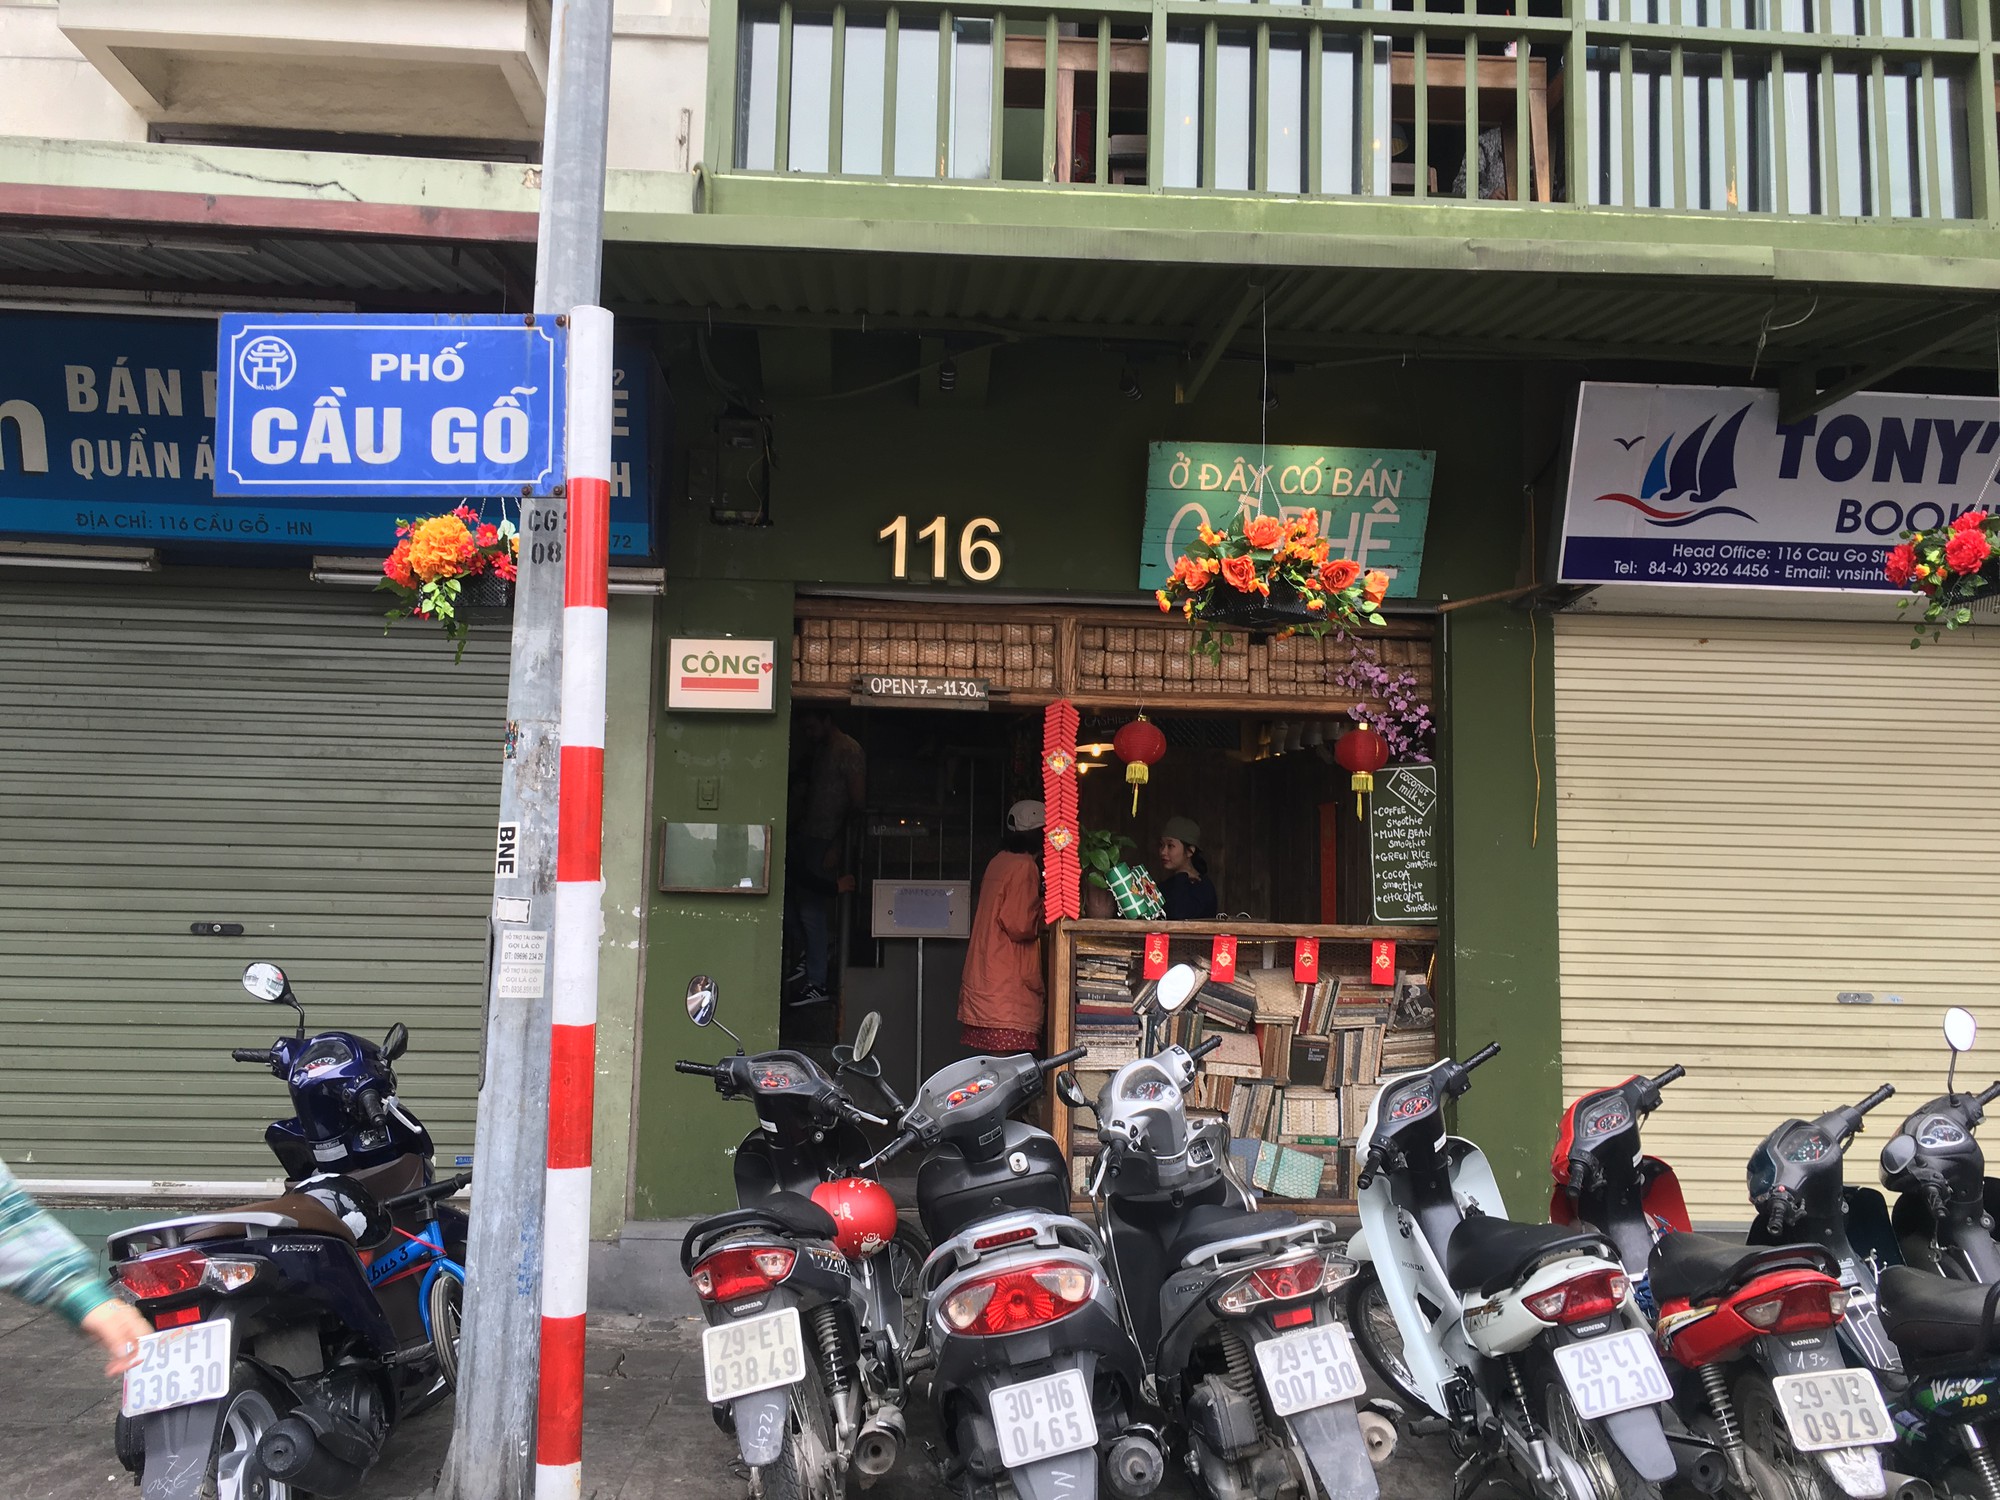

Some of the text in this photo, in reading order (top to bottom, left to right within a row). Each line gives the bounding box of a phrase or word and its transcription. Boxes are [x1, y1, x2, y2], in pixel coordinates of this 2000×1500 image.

[371, 341, 468, 382] PHỐ
[64, 356, 183, 417] BÁN
[251, 386, 402, 464] CẦU
[431, 386, 538, 464] GỖ
[71, 428, 181, 480] QUẦN
[1168, 452, 1402, 498] Ở ĐÂY CÓ BÁN
[76, 510, 109, 530] ĐỊA
[114, 510, 152, 529] CHỈ:
[159, 516, 189, 531] 116
[193, 512, 234, 532] CẦU
[238, 513, 269, 533] GỖ
[287, 521, 312, 535] HN
[877, 514, 1004, 582] 116
[1672, 544, 1716, 558] Head
[1720, 545, 1771, 560] Office:
[1777, 547, 1802, 560] 116
[1806, 548, 1839, 562] Cau
[1844, 550, 1867, 563] Go
[1614, 560, 1638, 574] Tel:
[1648, 562, 1688, 577] 84-4)
[1692, 563, 1728, 577] 3926
[1732, 564, 1770, 578] 4456
[1784, 566, 1830, 580] Email:
[681, 650, 760, 676] CỘNG
[1398, 784, 1418, 802] milk
[1400, 772, 1430, 796] coconut
[1378, 806, 1406, 817] COFFEE
[498, 826, 516, 875] BNE
[1408, 826, 1432, 840] BEAN
[1380, 851, 1410, 862] GREEN
[1382, 870, 1410, 880] COCOA
[733, 1300, 763, 1313] HONDA
[718, 1316, 785, 1360] 29-E1
[1576, 1322, 1606, 1334] HONDA
[1790, 1337, 1820, 1347] HONDA
[141, 1328, 213, 1373] 29-F1
[714, 1346, 798, 1394] 938.49
[1270, 1332, 1338, 1375] 29-E1
[1570, 1336, 1641, 1380] 29-C1
[132, 1361, 222, 1411] 336.30
[1004, 1378, 1075, 1423] 30-H6
[1274, 1362, 1356, 1408] 907.90
[1576, 1366, 1664, 1412] 272.30
[1790, 1376, 1867, 1410] 29-V2
[1930, 1377, 1984, 1404] Wave
[1962, 1394, 1988, 1408] 110
[1012, 1412, 1082, 1458] 0465
